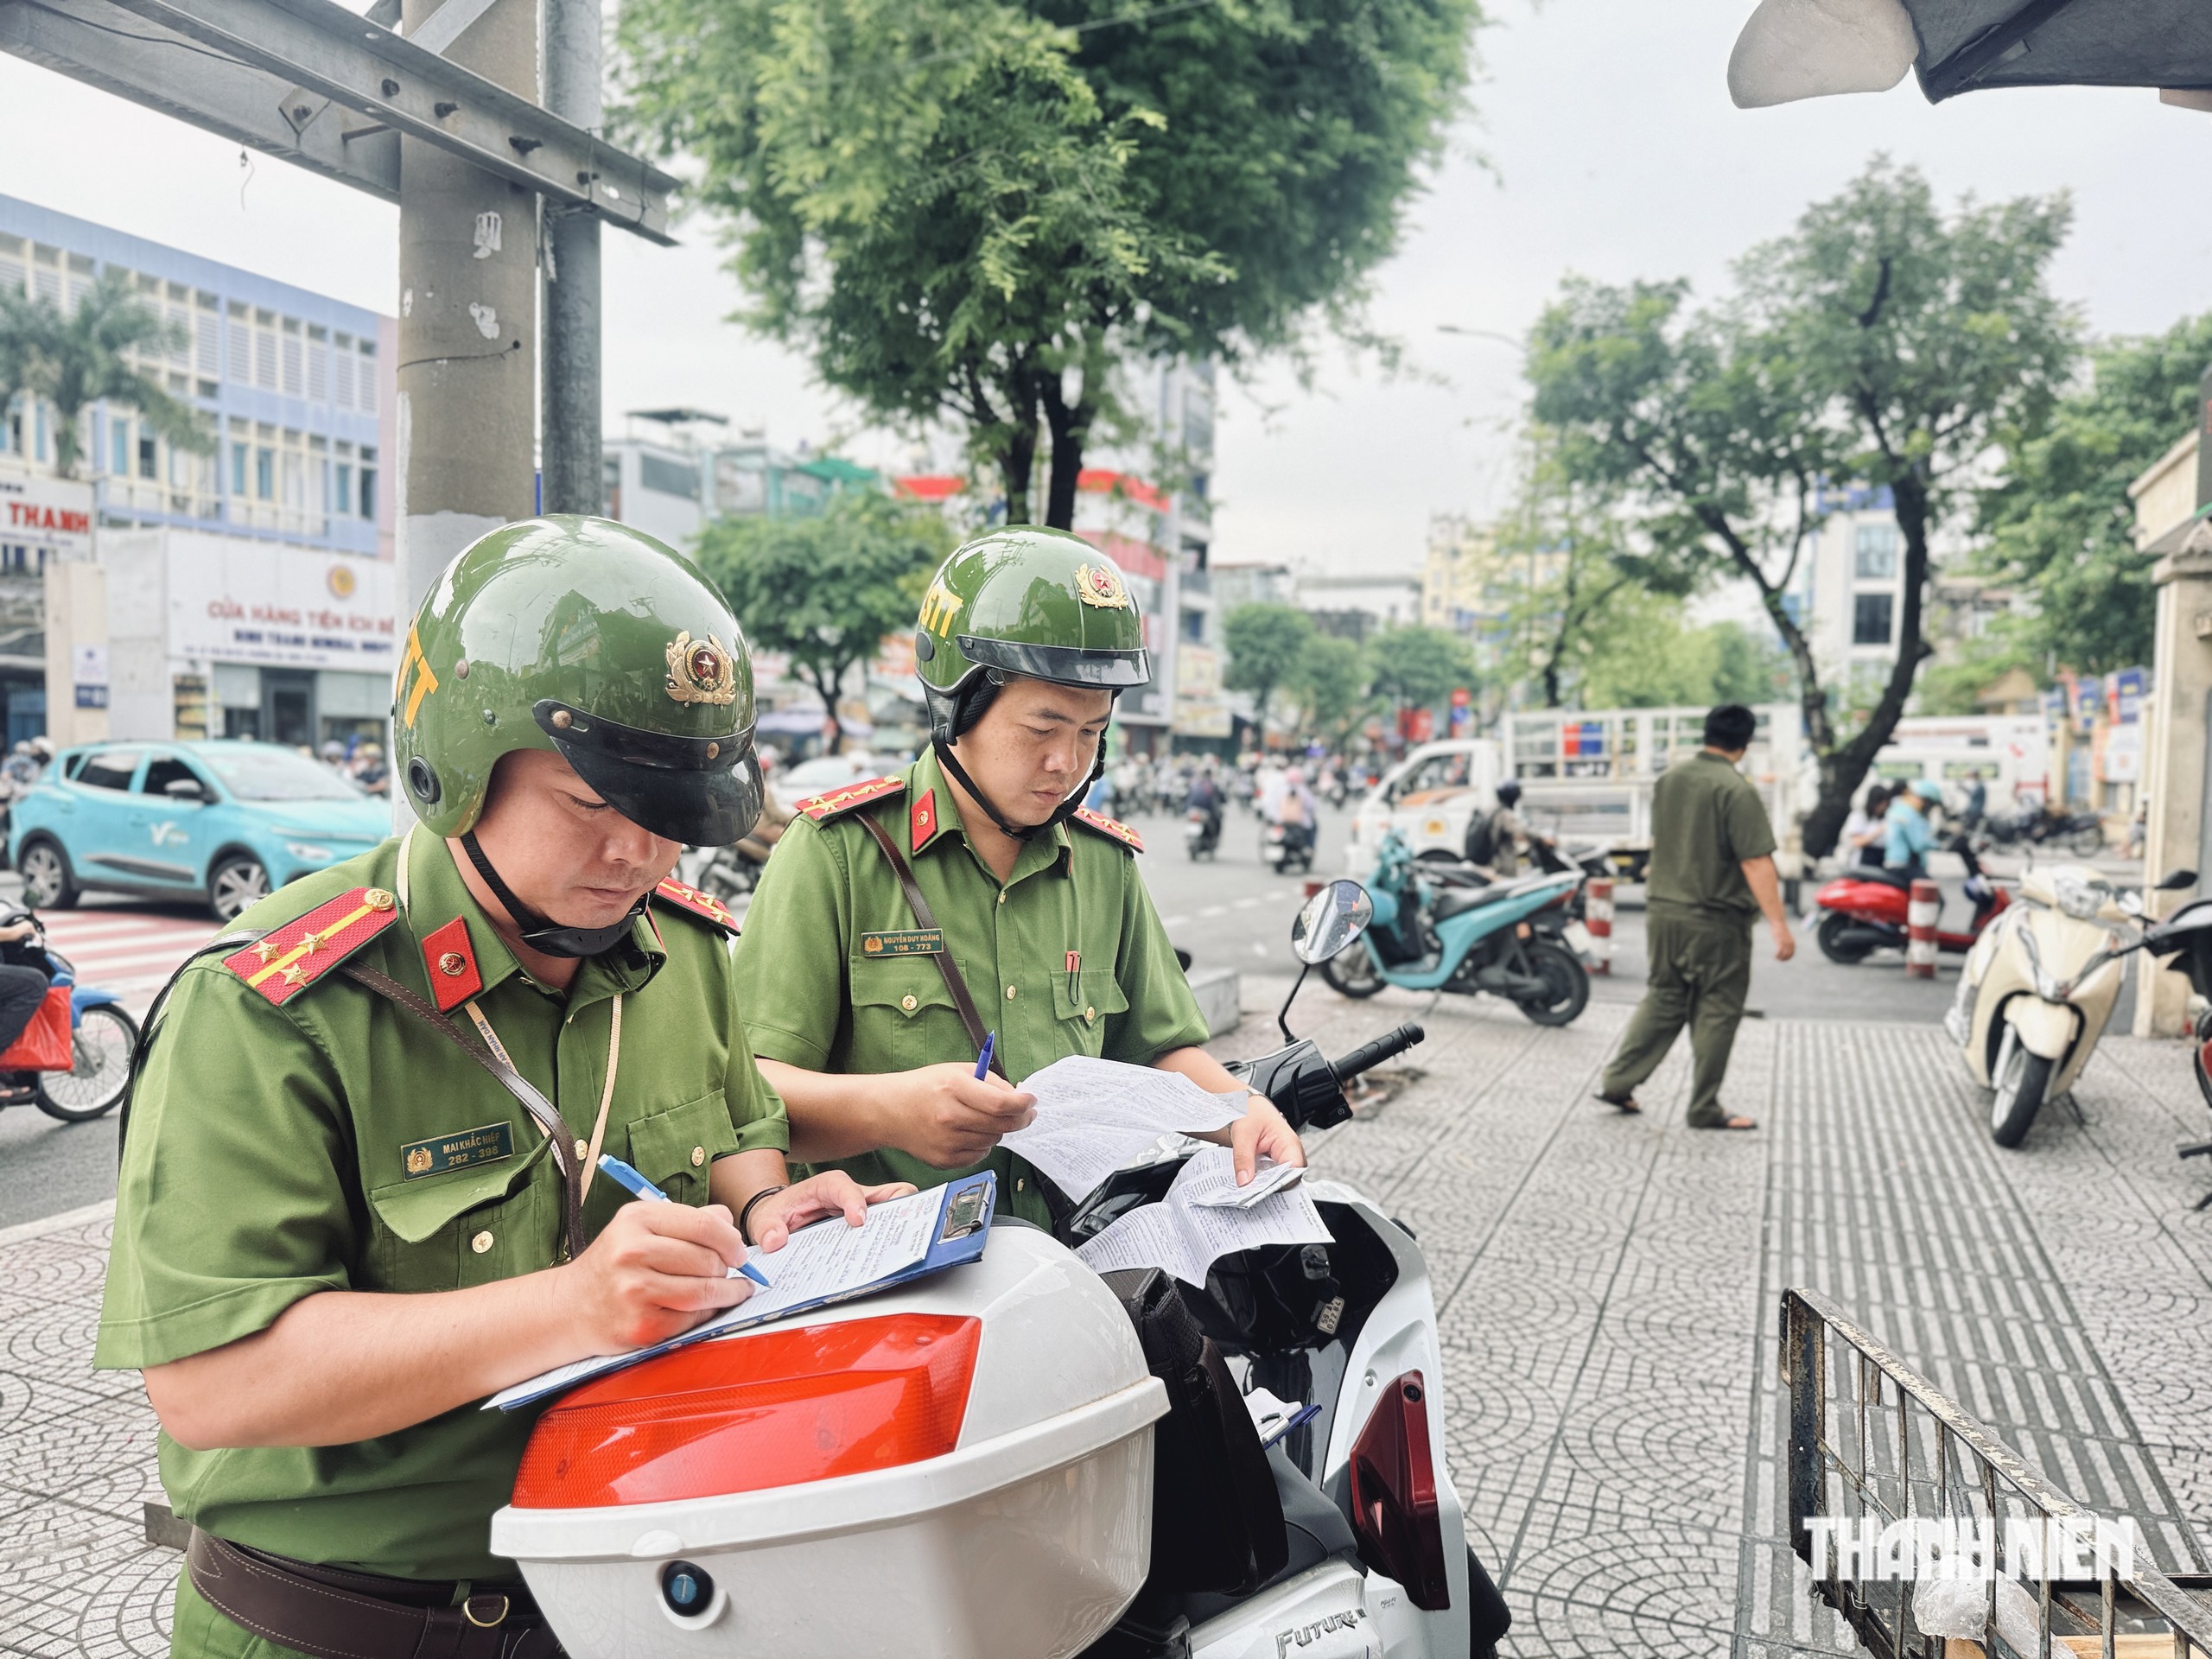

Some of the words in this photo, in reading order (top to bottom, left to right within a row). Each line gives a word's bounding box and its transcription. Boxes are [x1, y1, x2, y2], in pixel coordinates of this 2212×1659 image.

[442, 1141, 459, 1154] MAI
[448, 1153, 469, 1166] 282
[478, 1145, 499, 1159] 398
[1274, 1610, 1358, 1659] FUTURE
